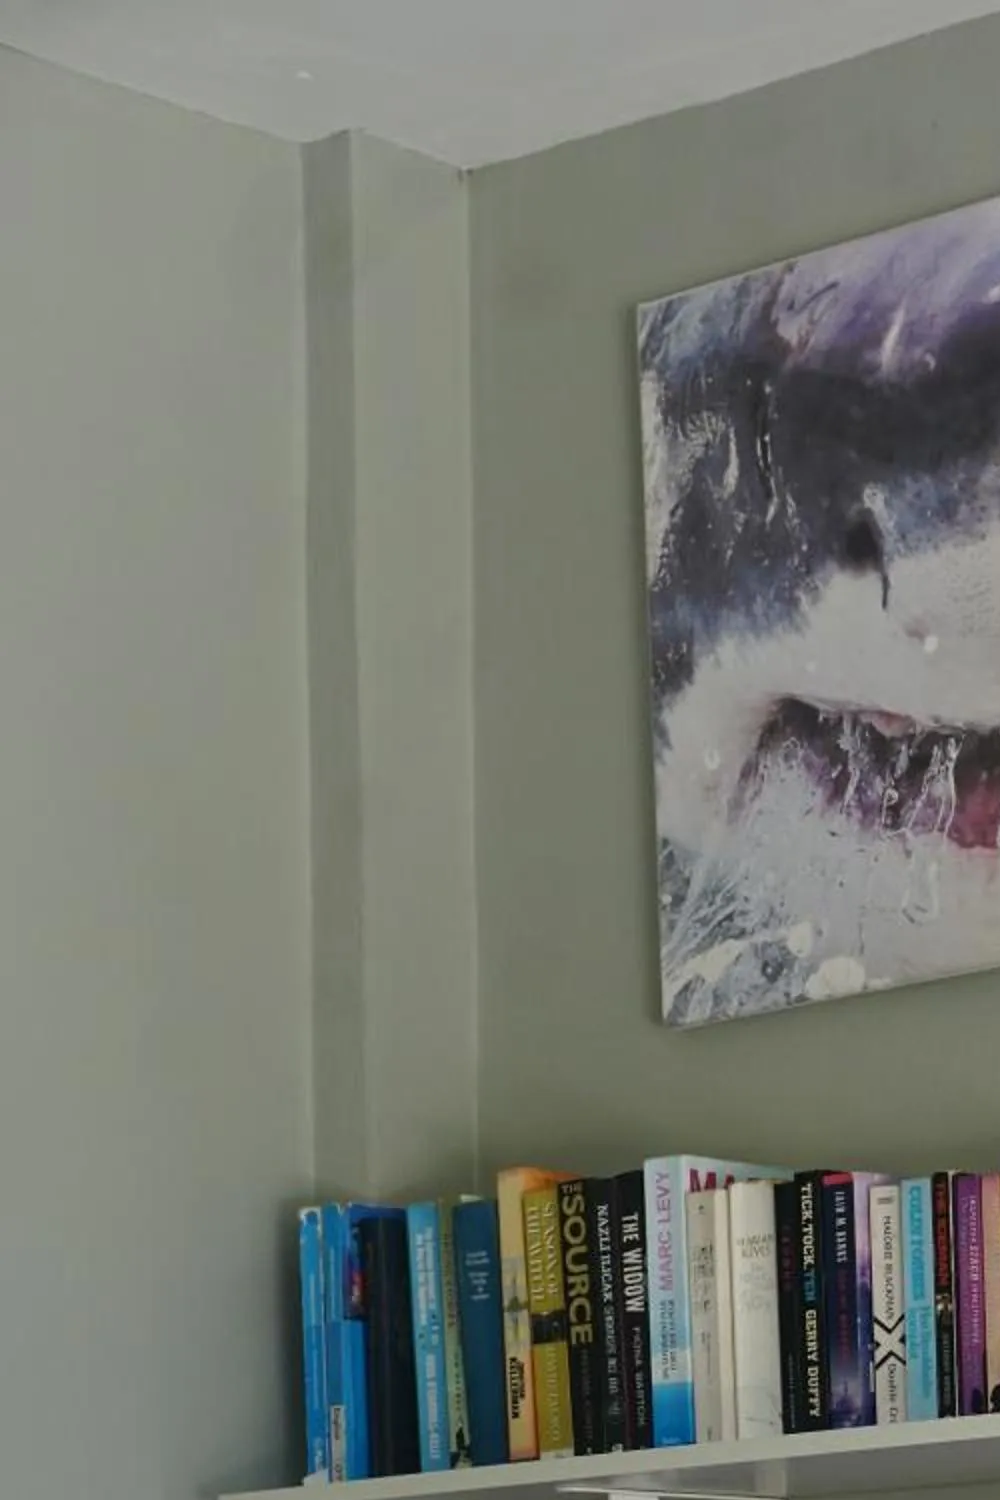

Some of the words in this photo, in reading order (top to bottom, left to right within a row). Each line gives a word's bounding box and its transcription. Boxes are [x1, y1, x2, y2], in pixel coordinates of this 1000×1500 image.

[656, 1172, 671, 1223] LEVY
[621, 1211, 640, 1243] THE
[561, 1194, 593, 1345] SOURCE
[621, 1247, 646, 1313] WIDOW
[657, 1231, 673, 1291] MARC
[805, 1309, 820, 1362] GERRY
[808, 1366, 822, 1417] DUFFY
